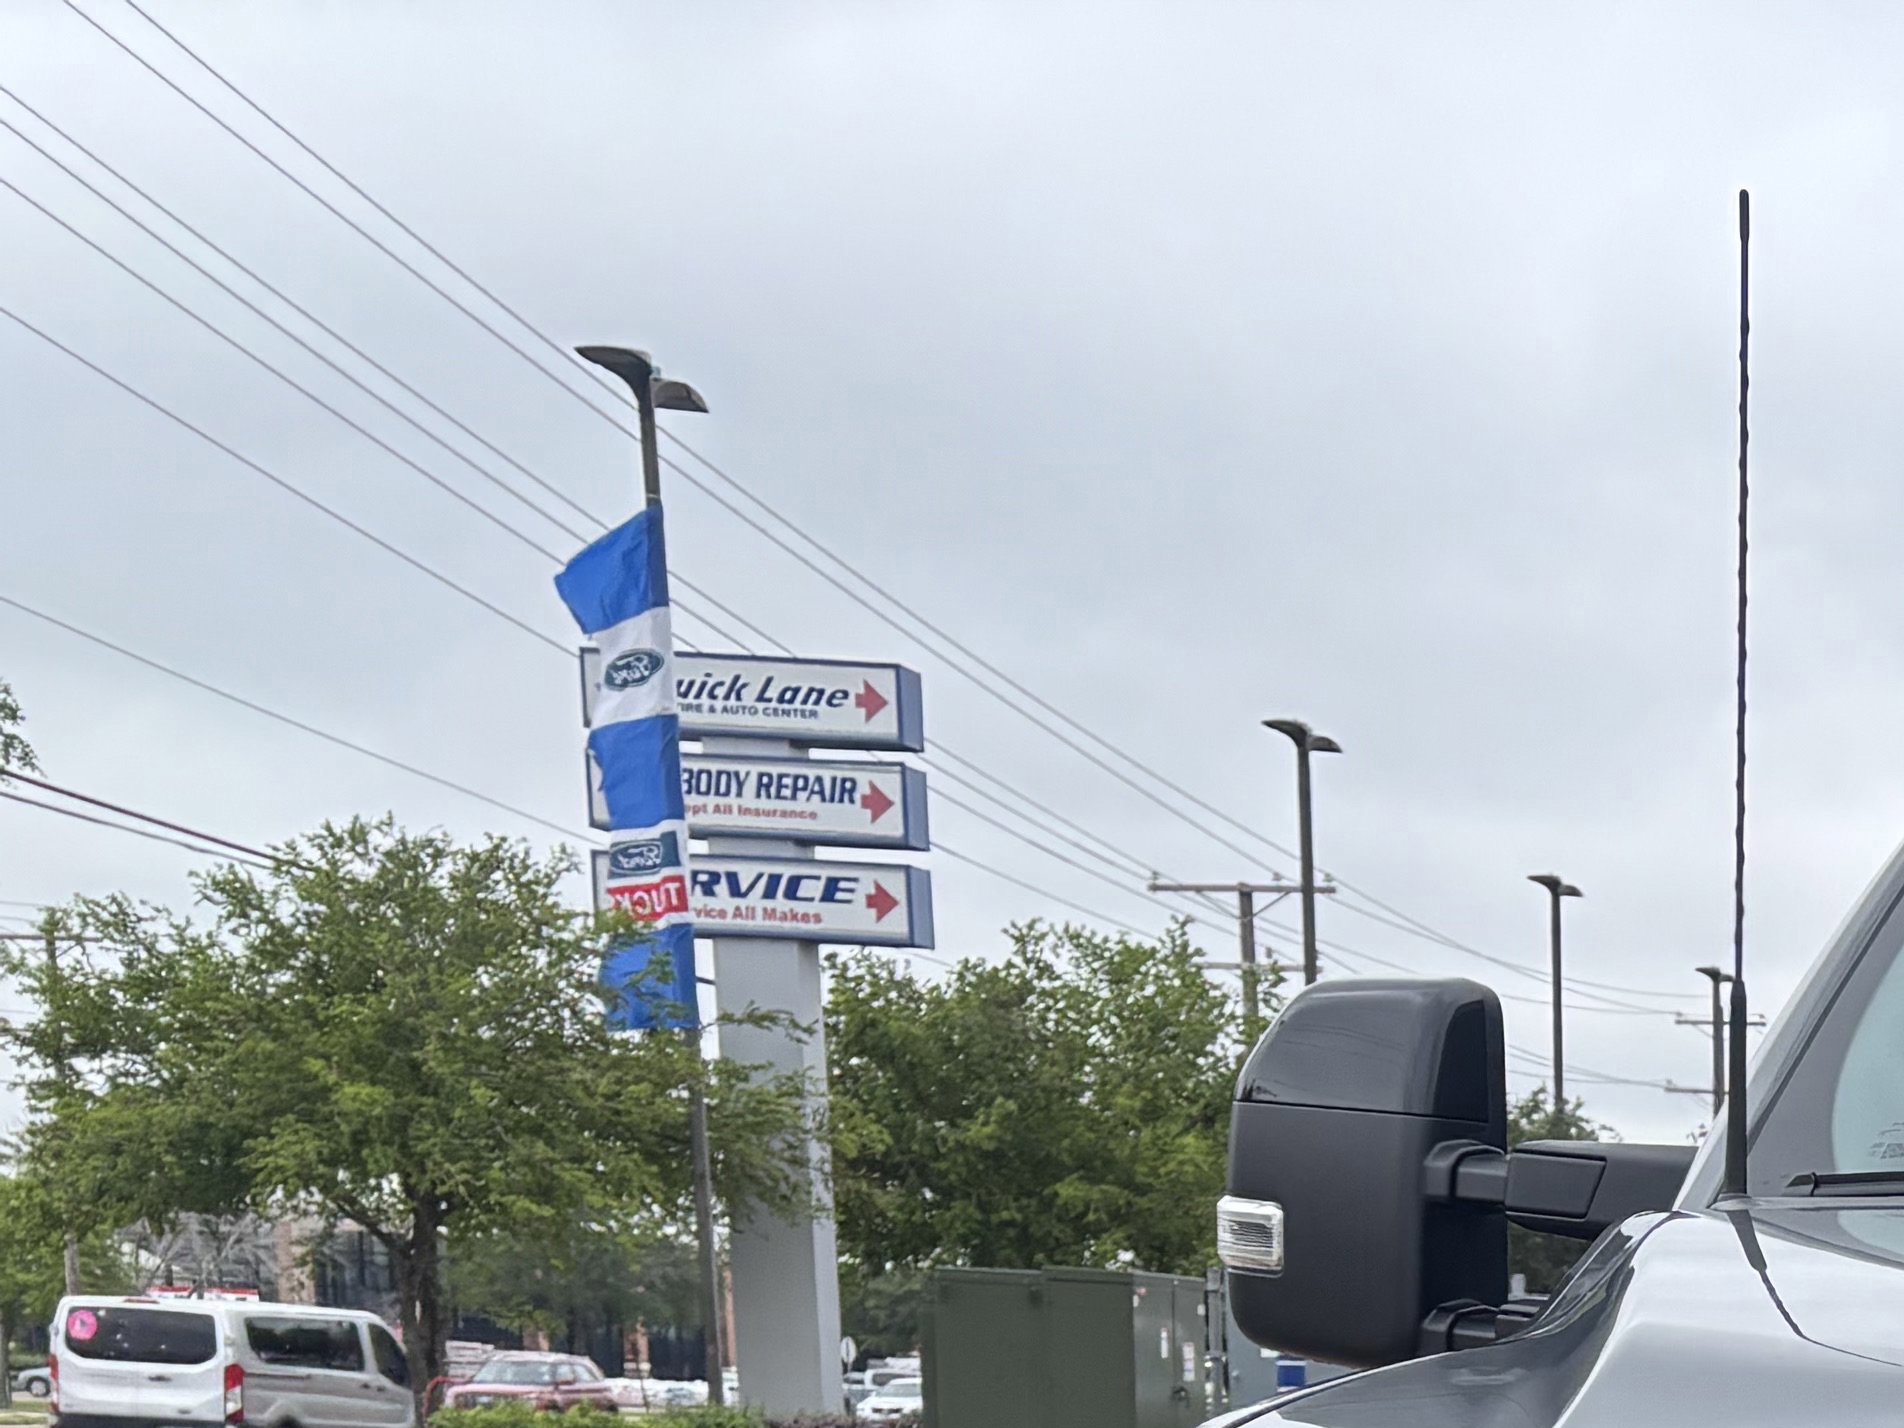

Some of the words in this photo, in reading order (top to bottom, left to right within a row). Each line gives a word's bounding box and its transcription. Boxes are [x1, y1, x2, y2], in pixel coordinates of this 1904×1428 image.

[676, 672, 750, 702] uick
[754, 675, 850, 708] Lane
[720, 705, 759, 717] AUTO
[762, 707, 819, 719] CENTER
[755, 771, 858, 805] REPAIR
[712, 804, 733, 816] All
[737, 805, 819, 820] Insurance
[690, 869, 860, 904] RVICE
[694, 906, 728, 920] vice
[733, 906, 756, 921] All
[762, 907, 823, 924] Makes
